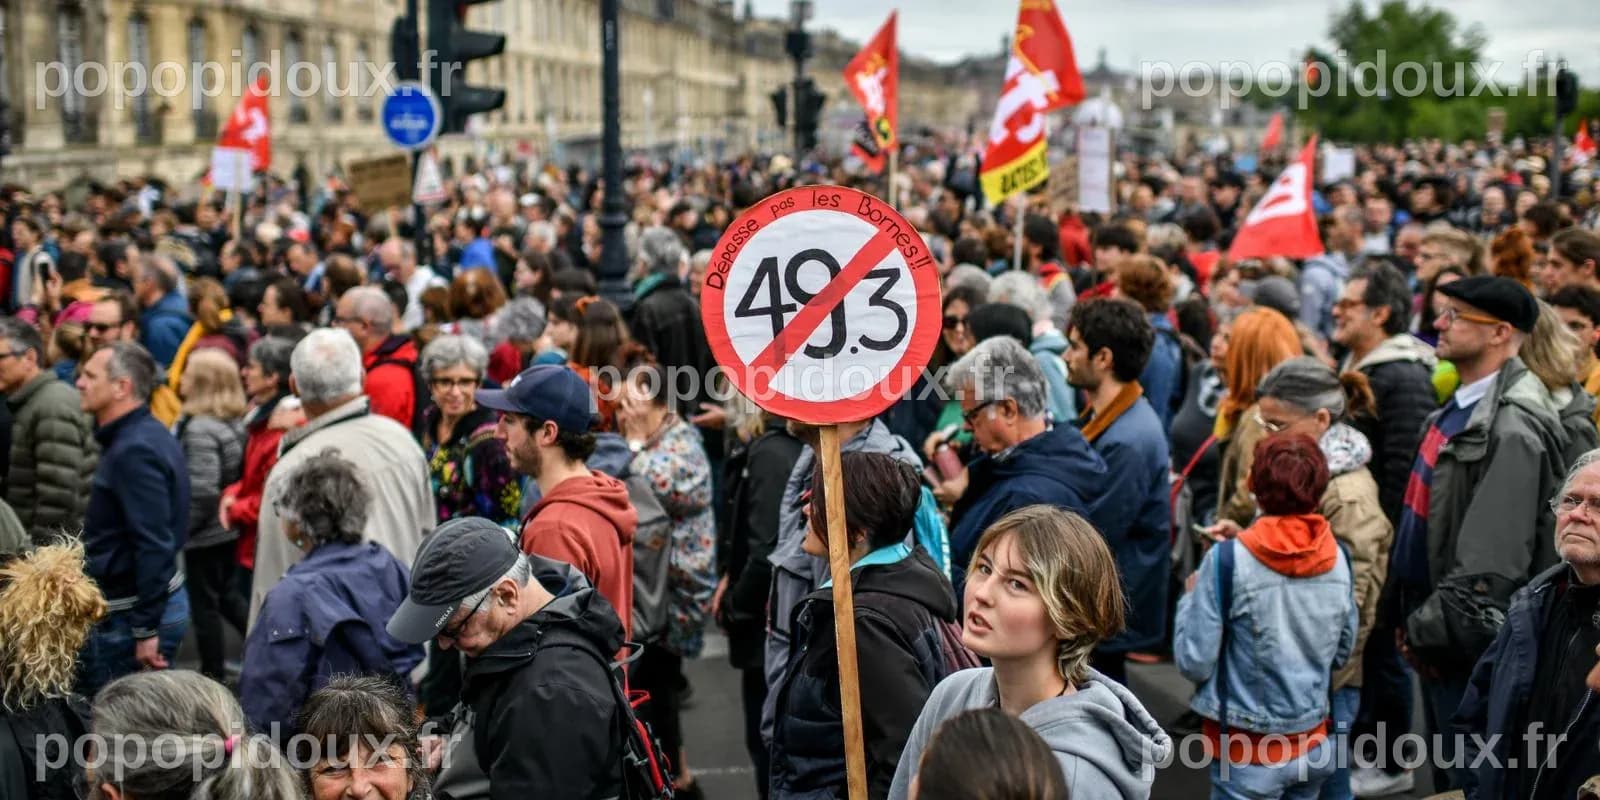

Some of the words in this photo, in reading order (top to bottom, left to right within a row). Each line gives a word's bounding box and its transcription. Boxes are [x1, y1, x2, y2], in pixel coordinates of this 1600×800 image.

[706, 219, 760, 290] Dépasse
[770, 197, 796, 218] pas
[812, 190, 841, 208] les
[734, 248, 908, 361] 49.3
